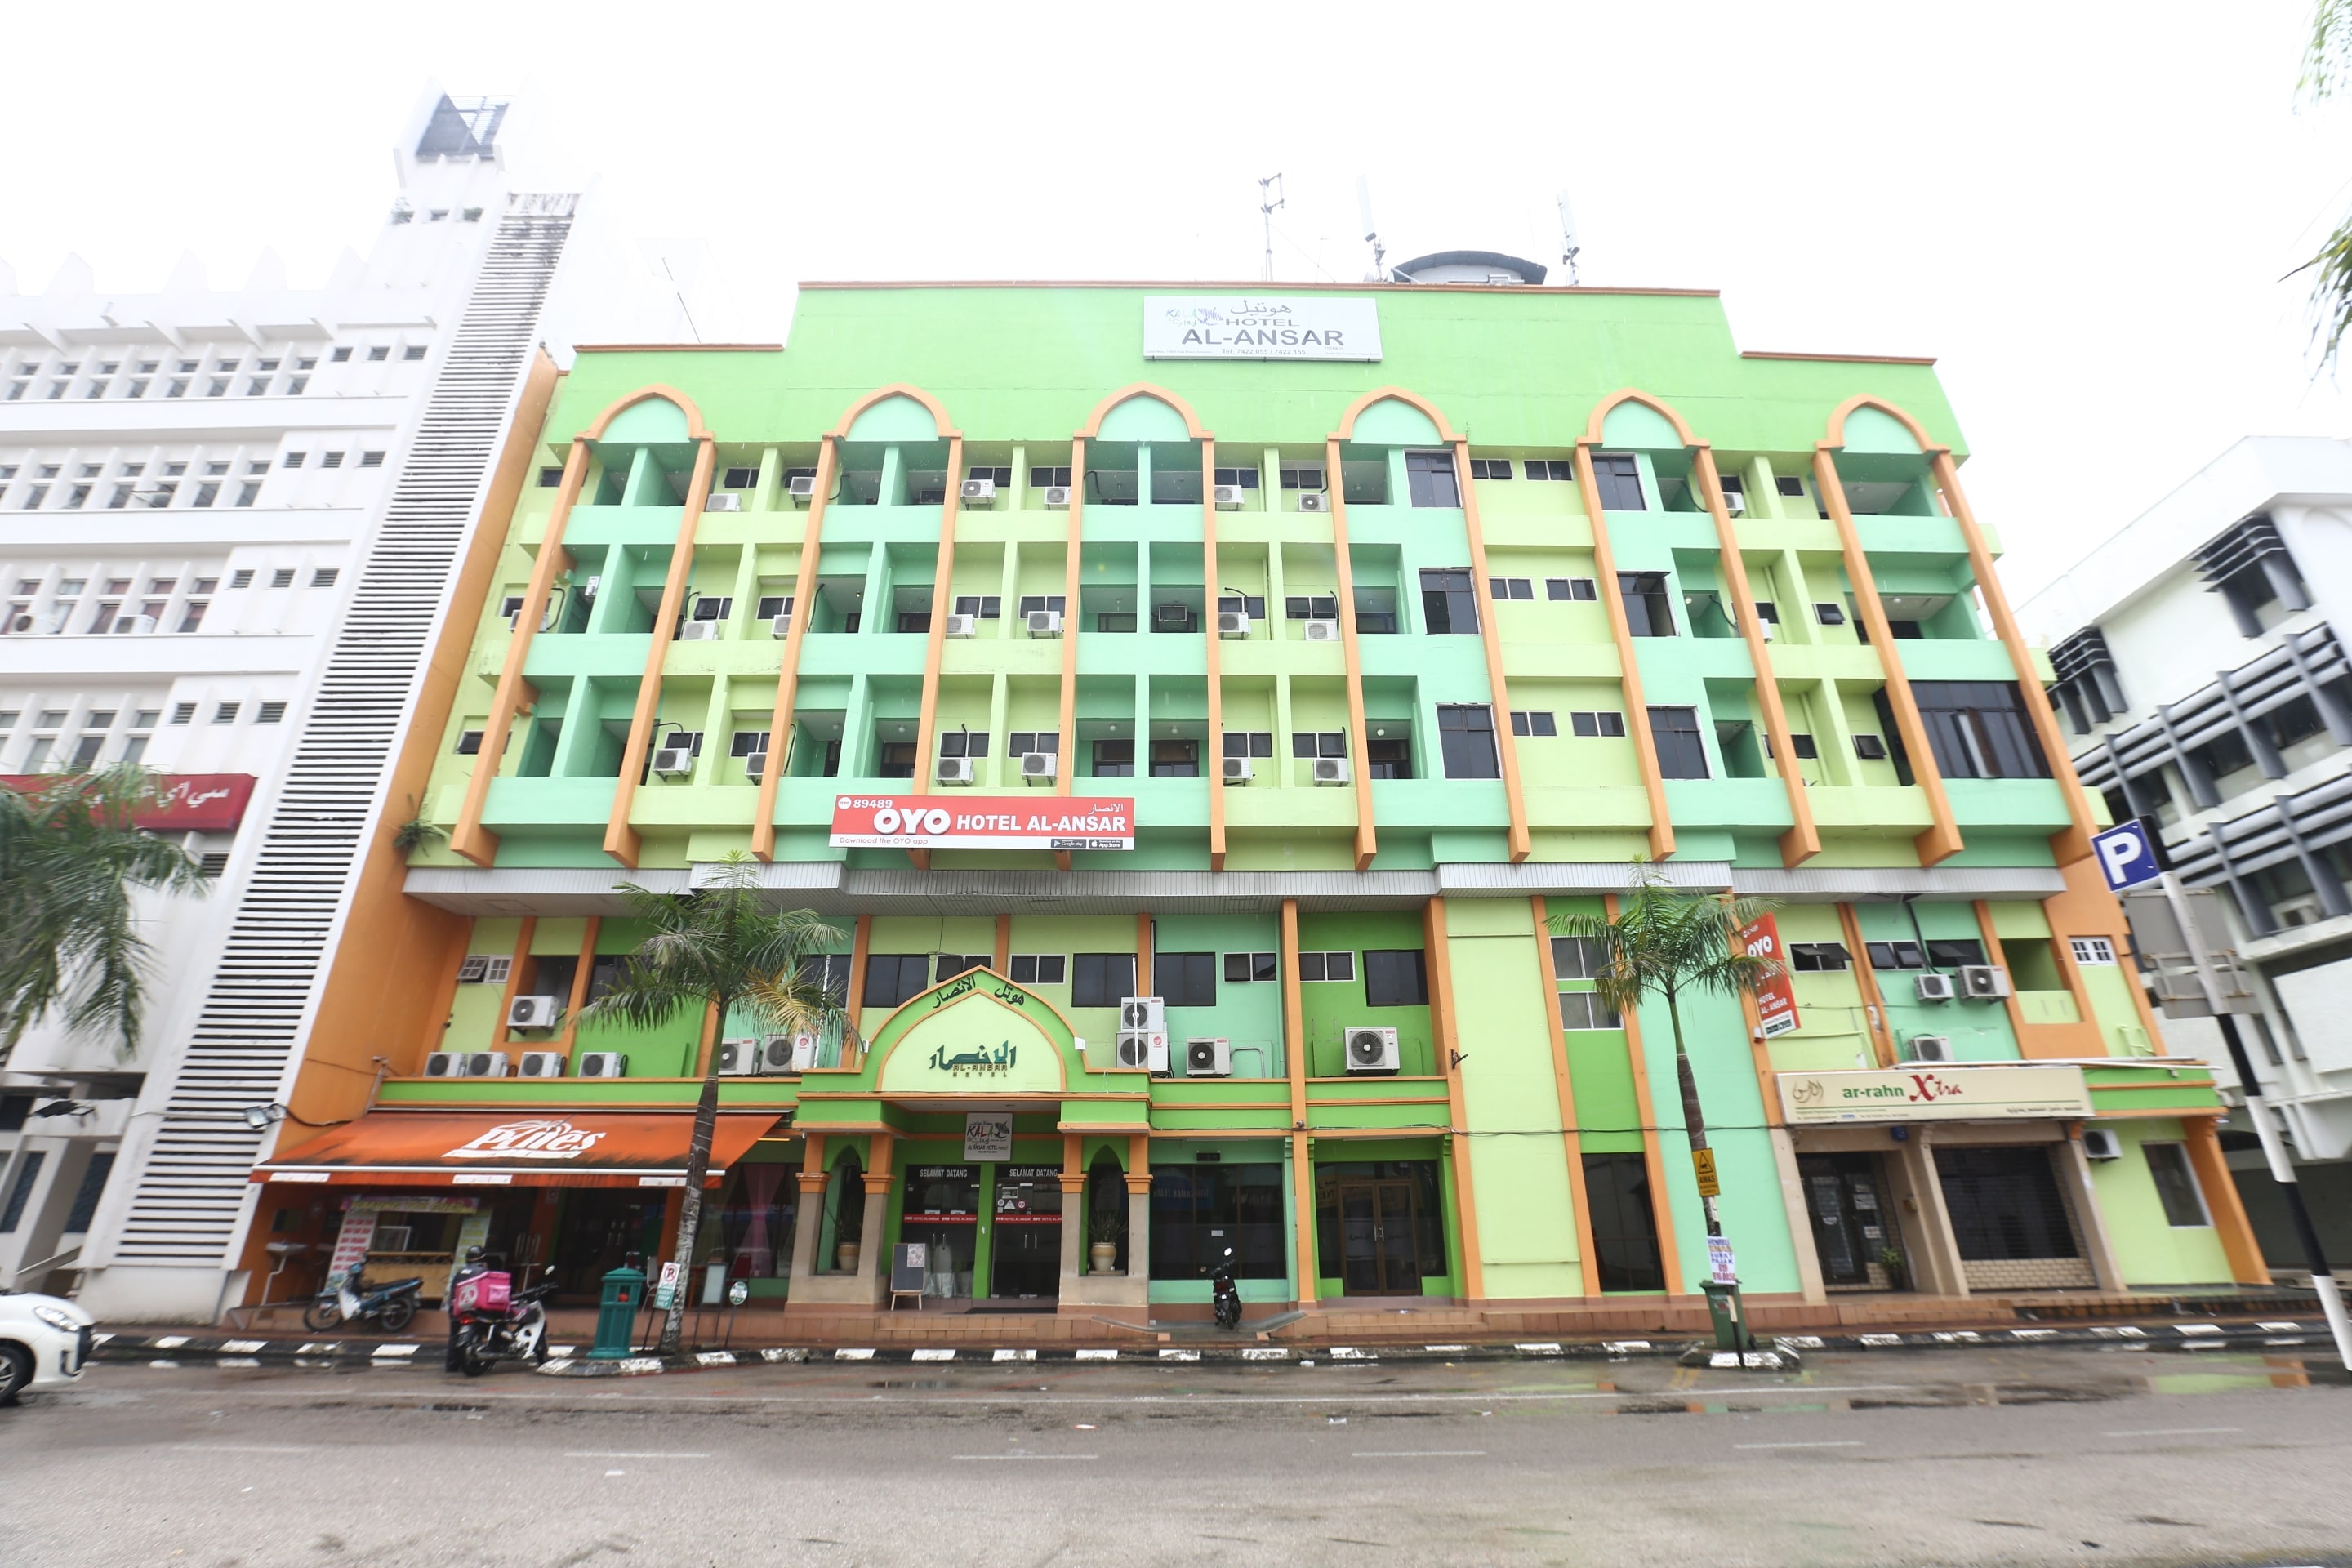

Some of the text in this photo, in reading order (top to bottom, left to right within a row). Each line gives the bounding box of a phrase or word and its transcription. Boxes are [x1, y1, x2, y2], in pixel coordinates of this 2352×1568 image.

[1225, 318, 1300, 327] HOTEL
[1181, 328, 1344, 346] AL-ANSAR
[853, 799, 893, 808] 89489
[873, 808, 1126, 835] OYO HOTEL AL-ANSAR
[912, 838, 929, 846] app
[2097, 831, 2142, 884] P
[1757, 992, 1776, 1005] HOTEL
[1842, 1073, 1963, 1102] ar-rahn Xtra
[967, 1125, 994, 1138] KALA
[920, 1169, 968, 1178] SELAMAT DATANG
[1009, 1169, 1058, 1177] SELAMAT DATANG
